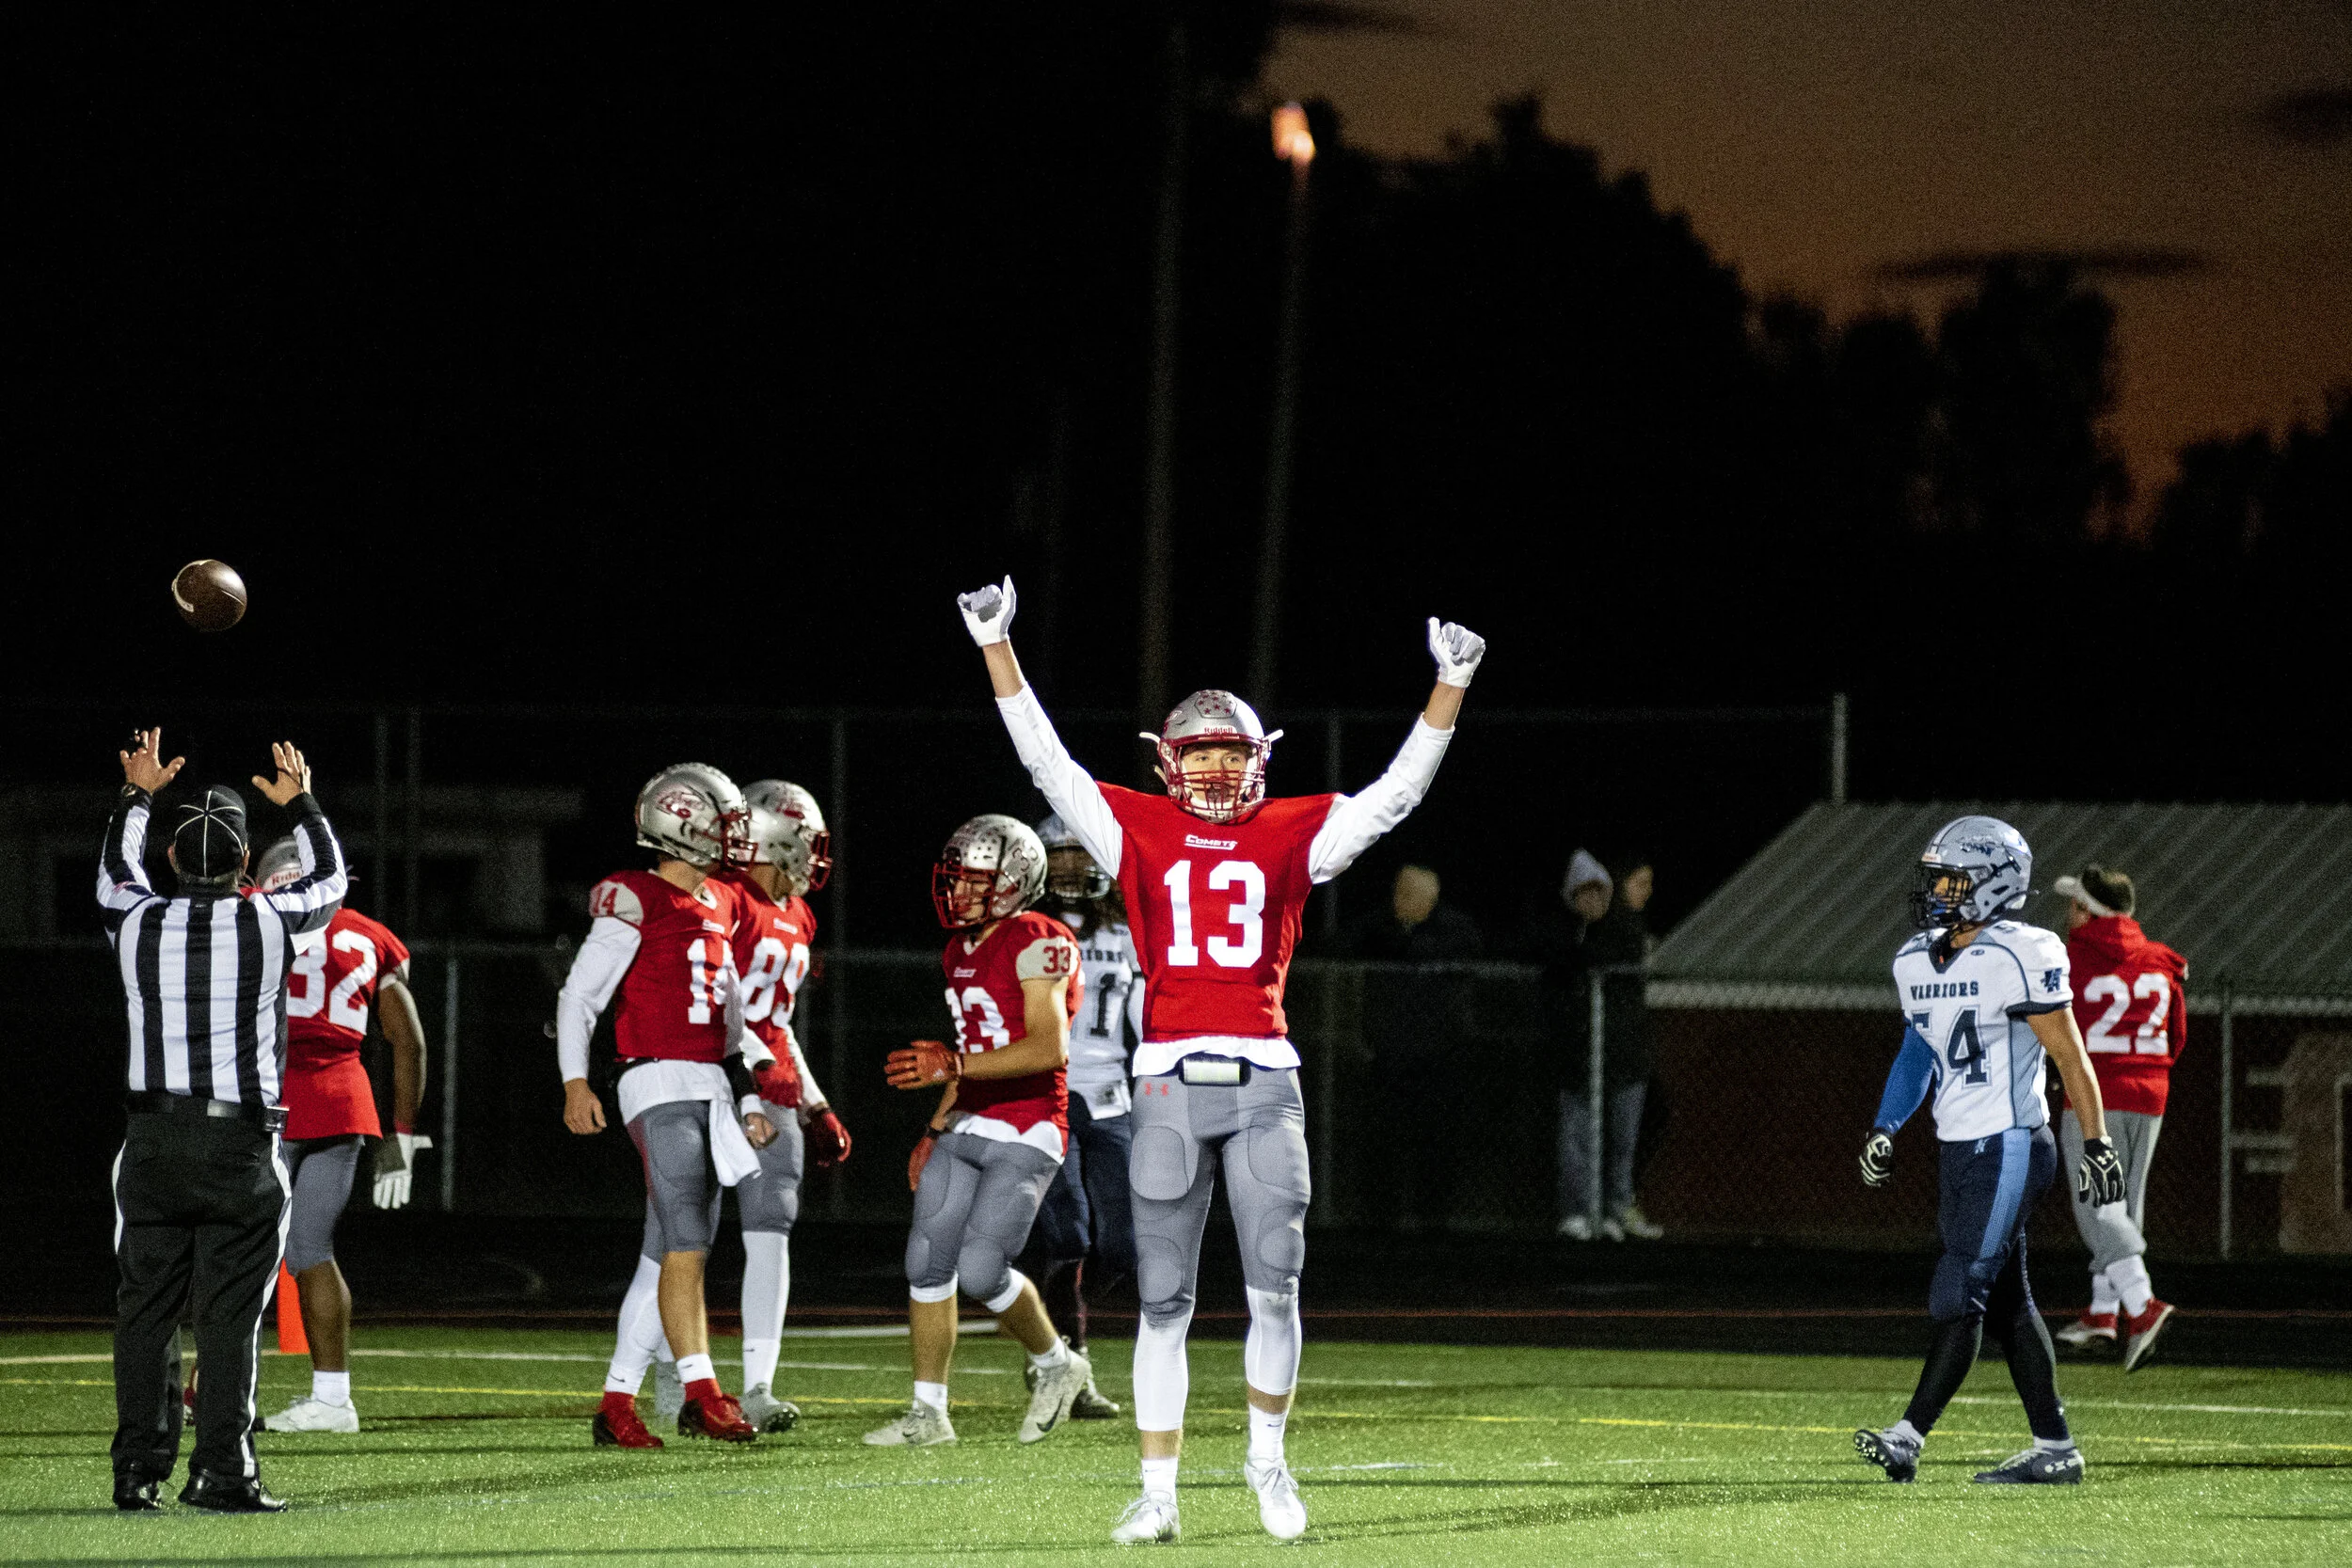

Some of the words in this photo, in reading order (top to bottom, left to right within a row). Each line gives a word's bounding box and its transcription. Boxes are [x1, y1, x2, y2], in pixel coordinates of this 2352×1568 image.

[591, 884, 618, 917] 14
[1164, 860, 1265, 968] 13
[1042, 946, 1071, 974] 33
[1910, 981, 1979, 1000] WARRIORS
[2084, 973, 2170, 1054] 22
